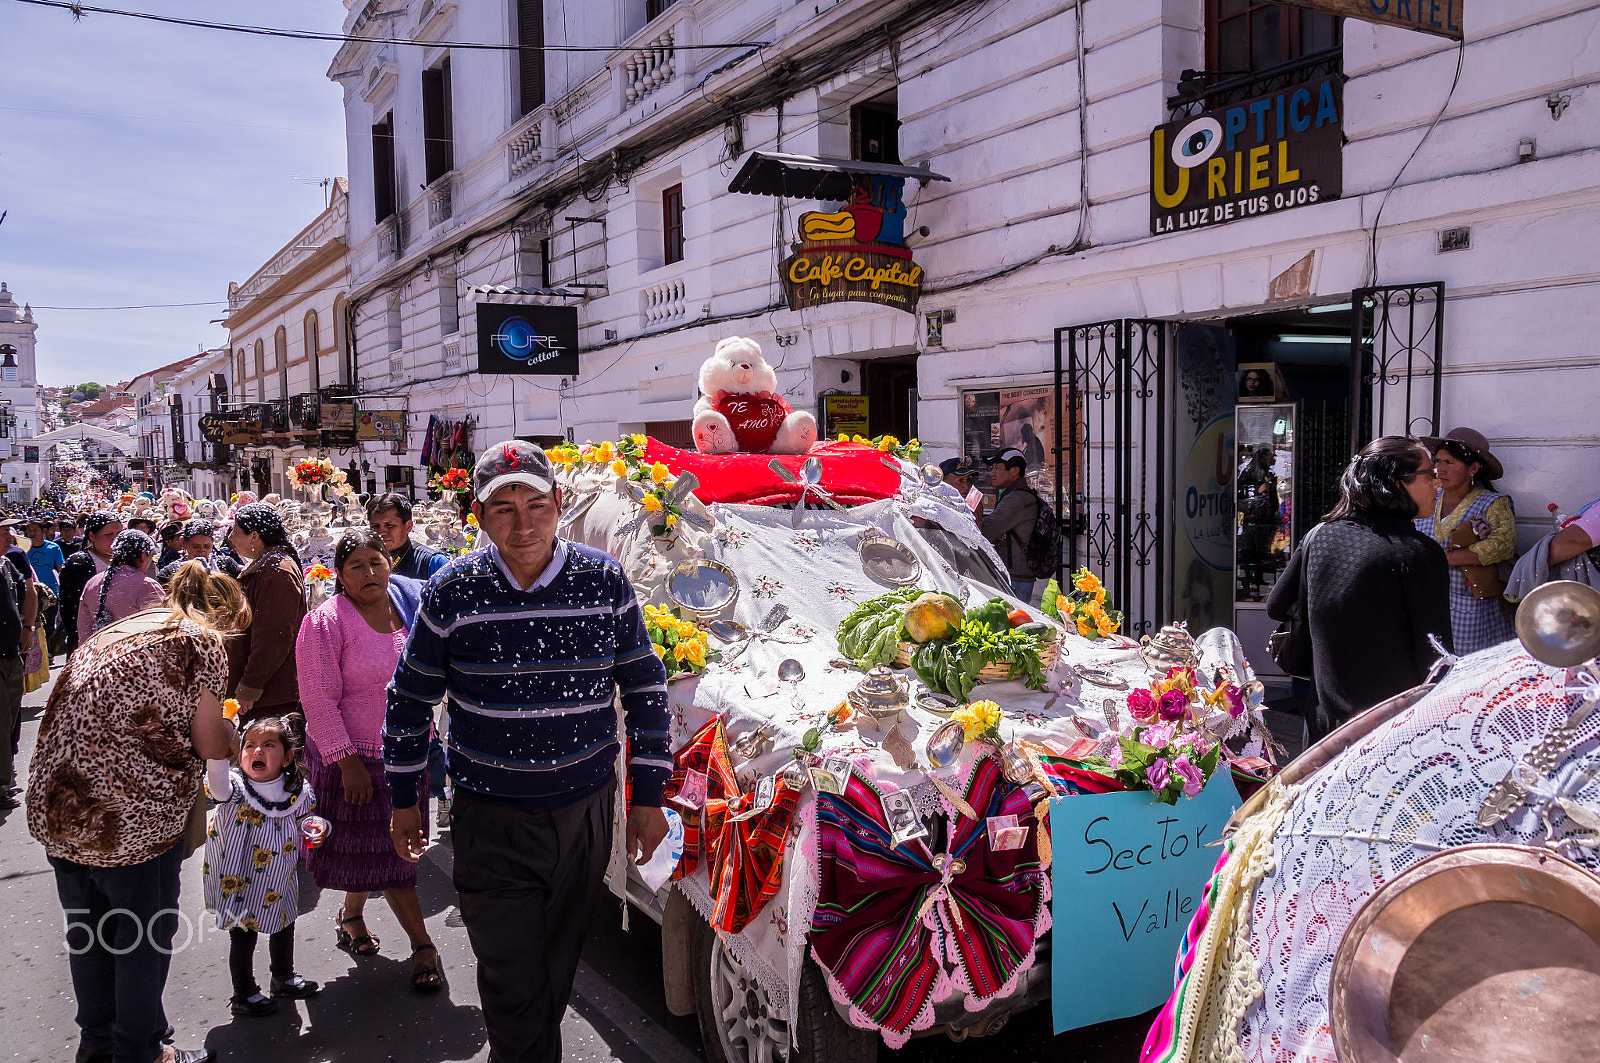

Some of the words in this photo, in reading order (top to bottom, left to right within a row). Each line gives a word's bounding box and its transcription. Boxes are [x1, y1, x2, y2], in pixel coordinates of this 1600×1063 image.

[1154, 128, 1299, 208] URIEL
[1156, 215, 1173, 232] LA
[1179, 208, 1211, 229] LUZ
[1214, 202, 1234, 222] DE
[1239, 196, 1270, 217] TUS
[1274, 185, 1320, 209] OJOS
[789, 255, 844, 286] Café
[844, 257, 922, 289] Capital
[847, 289, 868, 301] para
[490, 334, 567, 350] PURE
[527, 349, 560, 366] cotton
[1011, 390, 1023, 398] BEST
[1023, 387, 1049, 396] CONCERTS
[727, 401, 749, 414] TE
[737, 418, 769, 431] AMO
[1085, 816, 1208, 875] Sector
[1112, 888, 1193, 942] Valle
